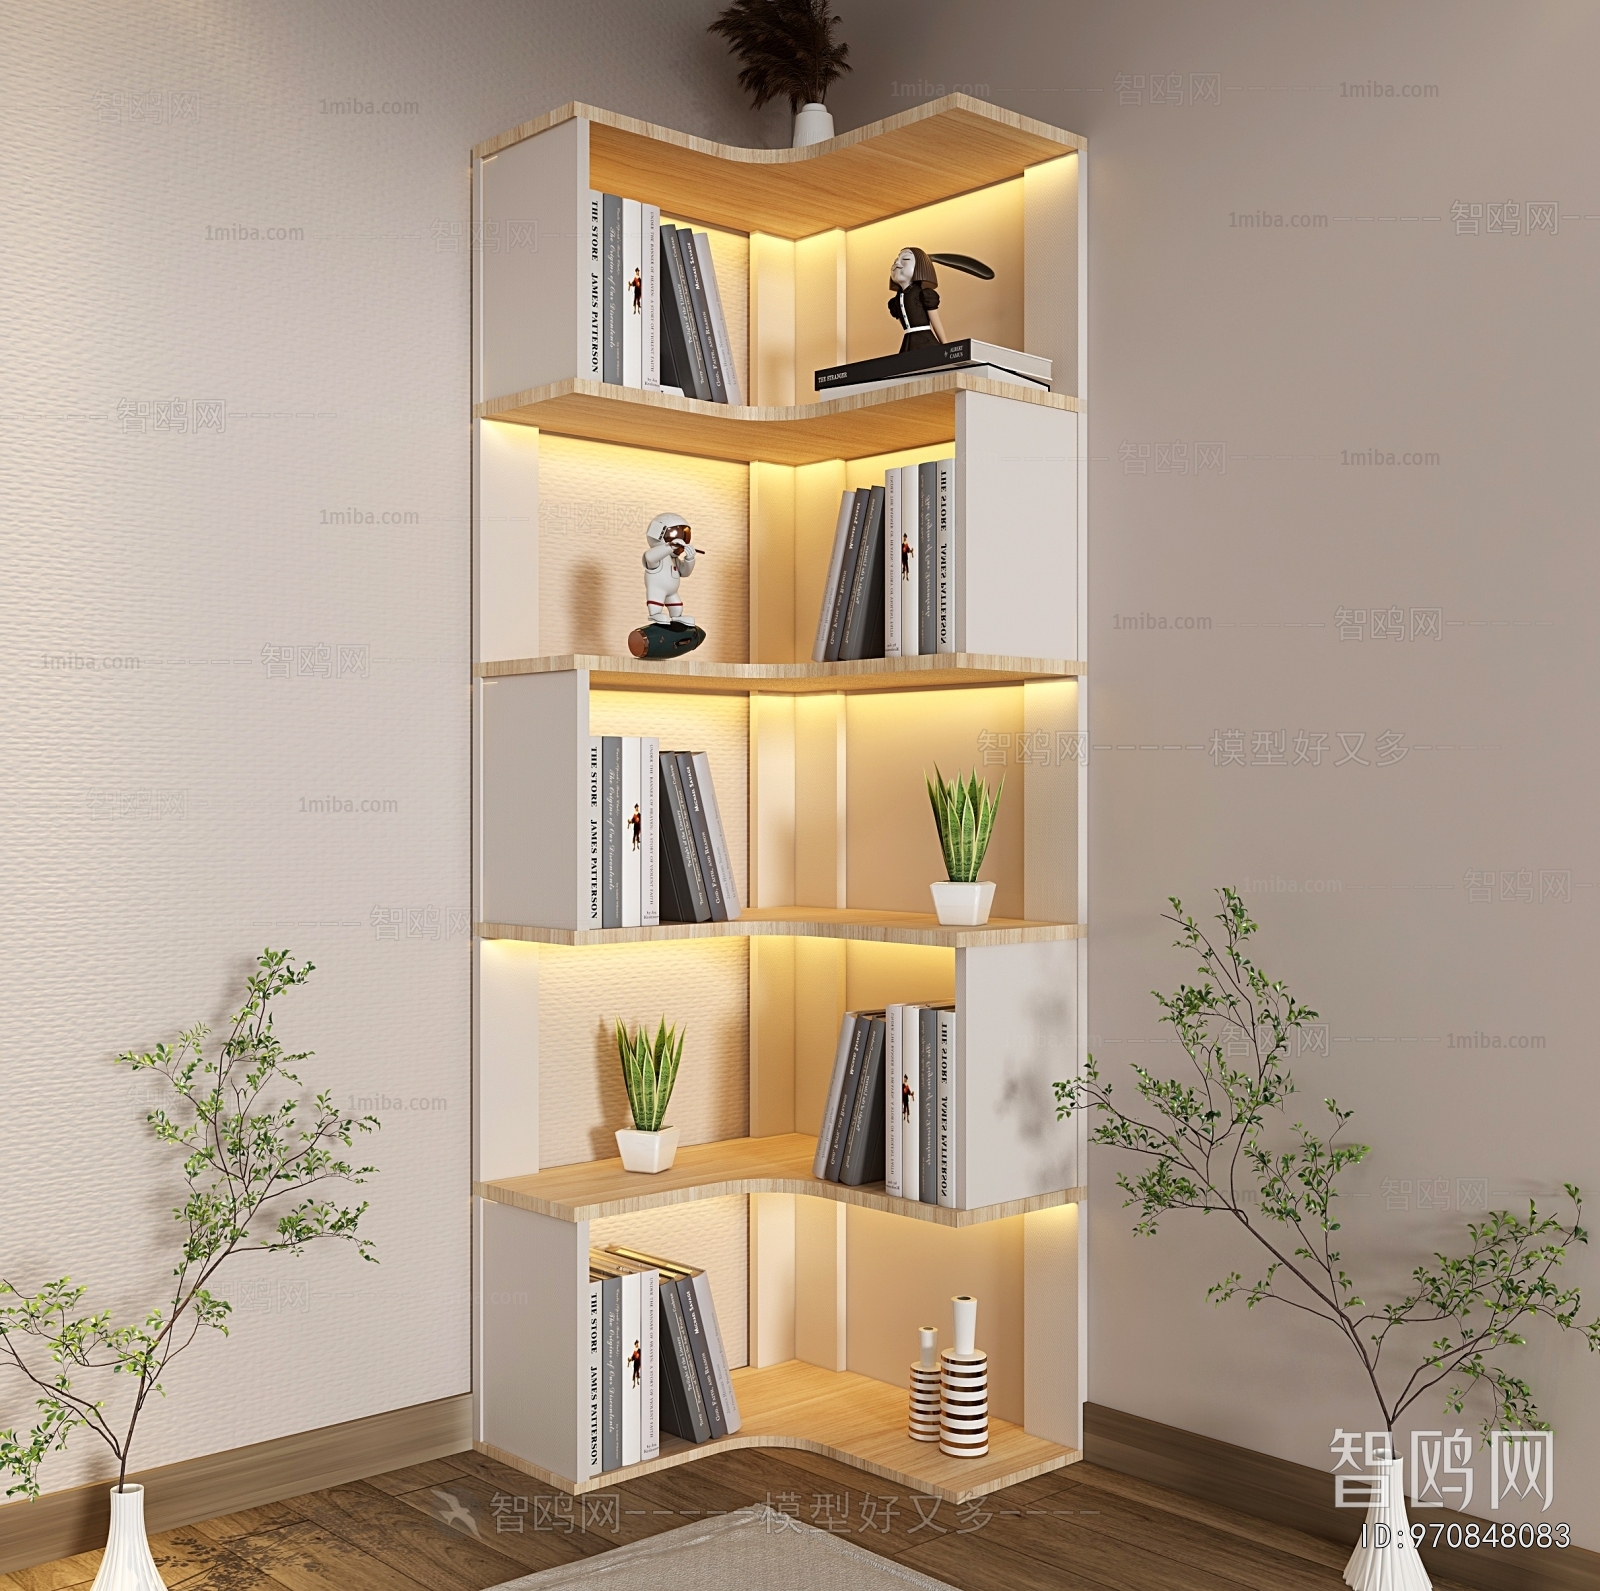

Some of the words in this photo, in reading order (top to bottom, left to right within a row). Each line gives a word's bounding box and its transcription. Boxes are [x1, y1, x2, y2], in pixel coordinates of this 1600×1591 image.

[608, 245, 616, 273] Origins
[607, 787, 615, 815] Origins
[607, 1330, 615, 1358] Origins
